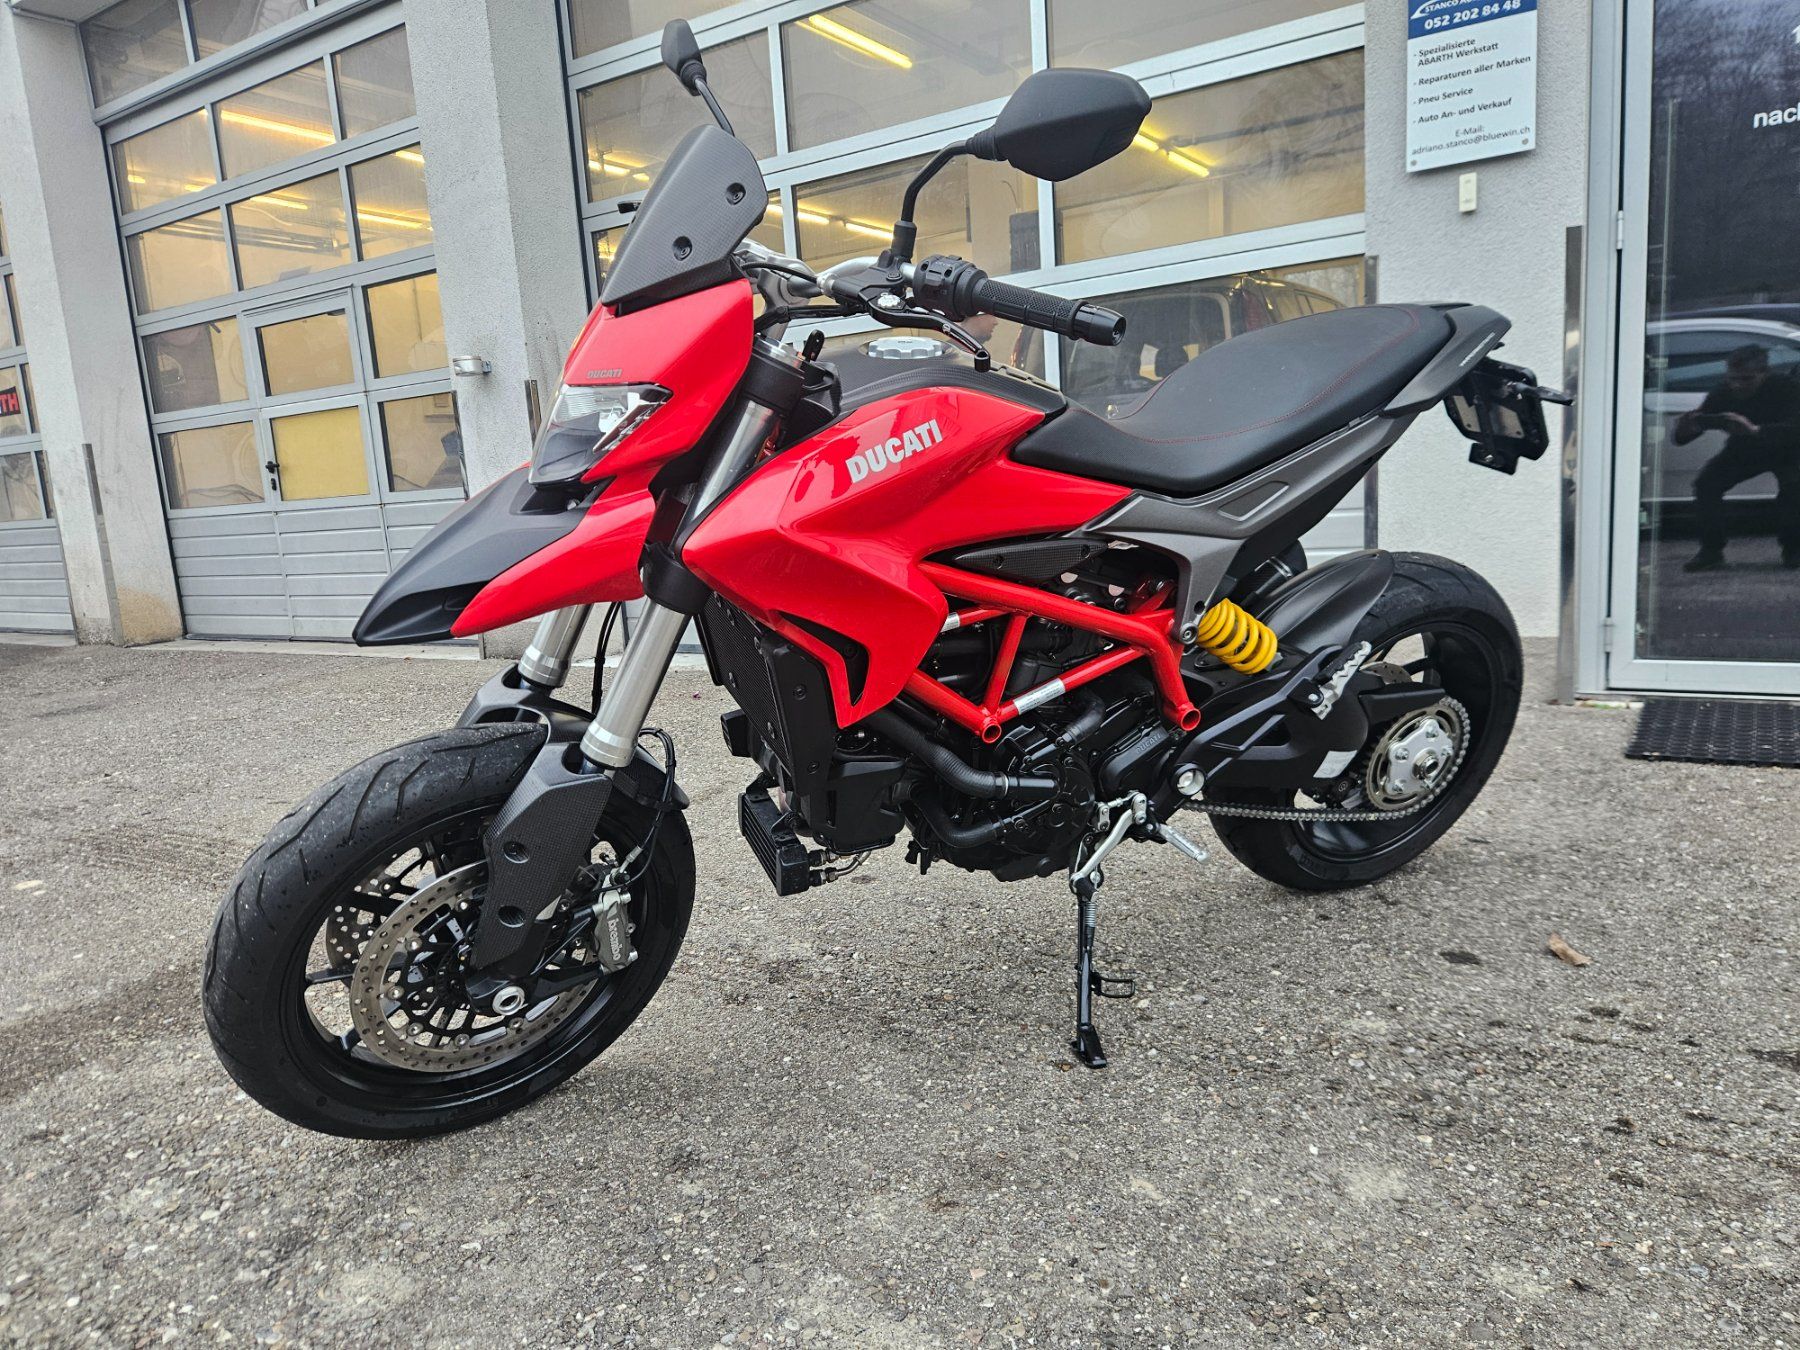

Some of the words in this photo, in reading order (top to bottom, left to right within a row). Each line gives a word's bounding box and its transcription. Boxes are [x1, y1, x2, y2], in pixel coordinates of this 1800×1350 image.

[1424, 15, 1450, 30] 052
[1453, 7, 1479, 24] 202
[1482, 3, 1500, 17] 84
[1502, 0, 1521, 11] 48
[1418, 38, 1476, 58] Spezialisierte
[1418, 53, 1454, 67] ABARTH
[1456, 42, 1499, 58] Werkstatt
[1418, 69, 1472, 87] Reparaturen
[1474, 63, 1494, 75] aller
[1496, 56, 1531, 69] Marken
[1418, 93, 1440, 105] Pneu
[1442, 87, 1474, 100] Service
[1418, 112, 1439, 124] Auto
[1458, 104, 1475, 116] und
[1478, 97, 1513, 112] Verkauf
[1411, 126, 1531, 155] adriano.stanco@bluewin.ch
[1455, 125, 1485, 137] E-Mail:
[587, 368, 623, 379] DUCATI
[0, 392, 20, 413] TH
[845, 418, 943, 484] DUCATI
[607, 917, 623, 961] brembo
